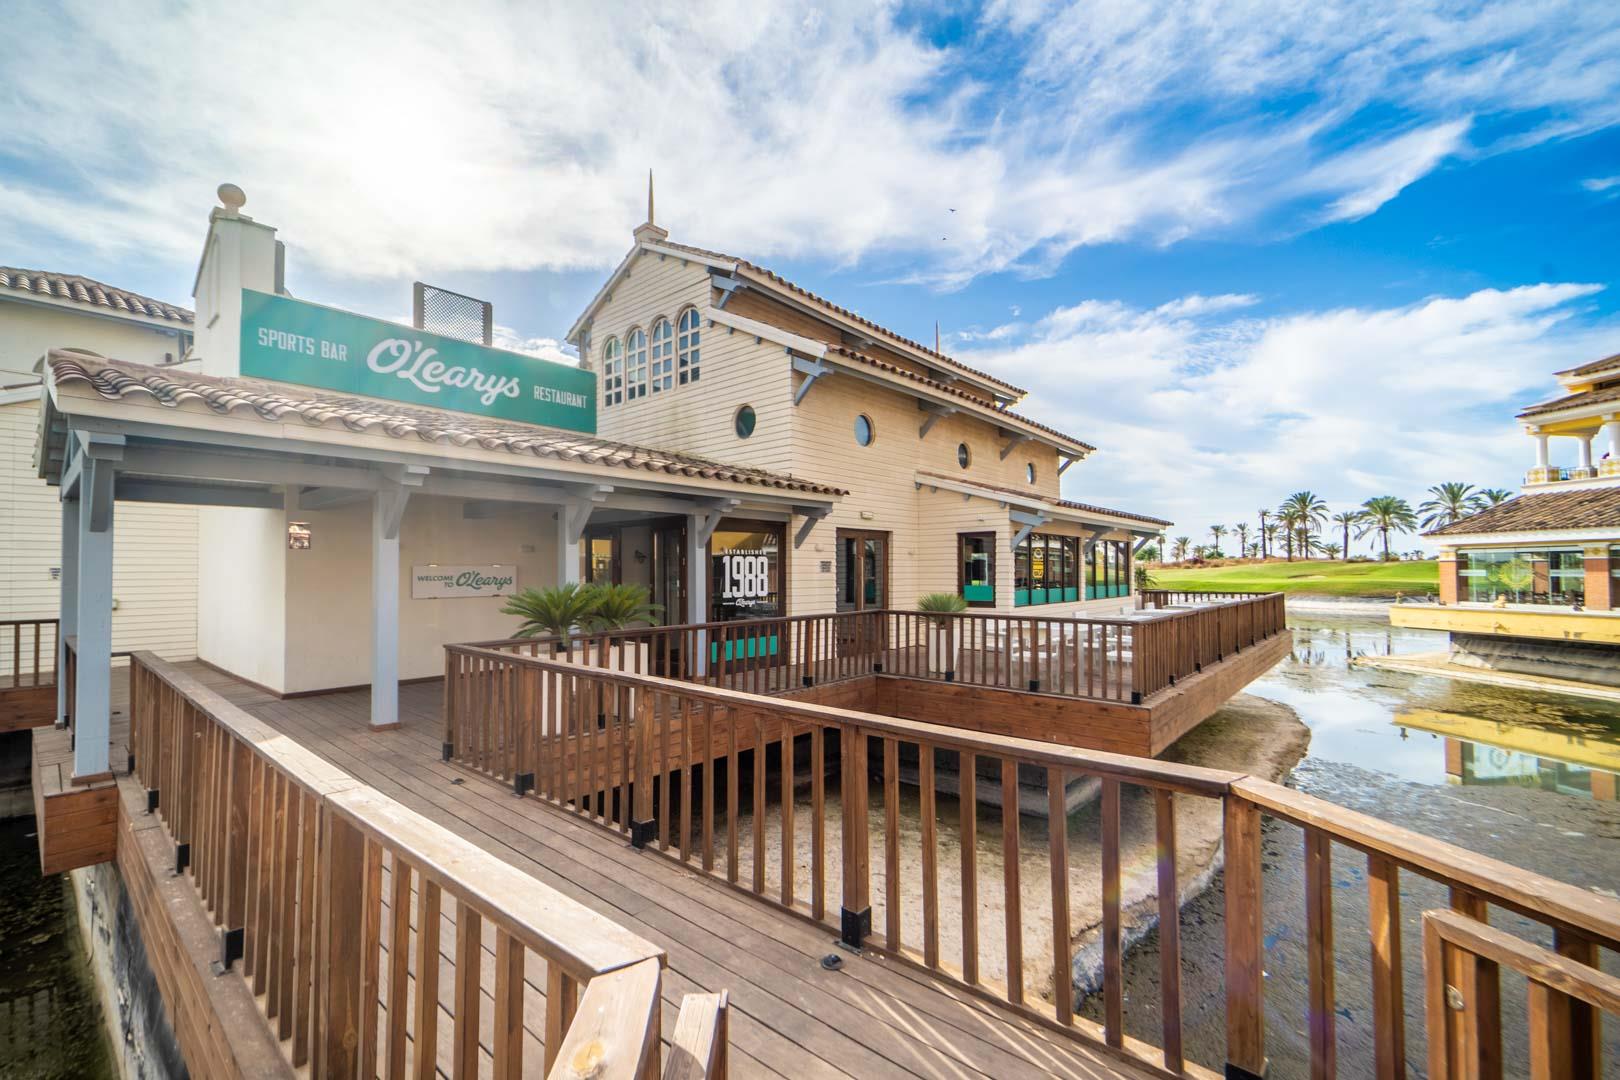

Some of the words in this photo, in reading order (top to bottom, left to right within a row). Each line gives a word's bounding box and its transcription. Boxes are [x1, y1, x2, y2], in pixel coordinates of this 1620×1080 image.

[258, 327, 315, 356] SPORTS
[320, 340, 348, 362] BAR
[366, 338, 520, 406] O'Learys
[533, 385, 587, 409] RESTAURANT
[456, 570, 513, 591] O'Learys
[722, 555, 769, 598] 1988
